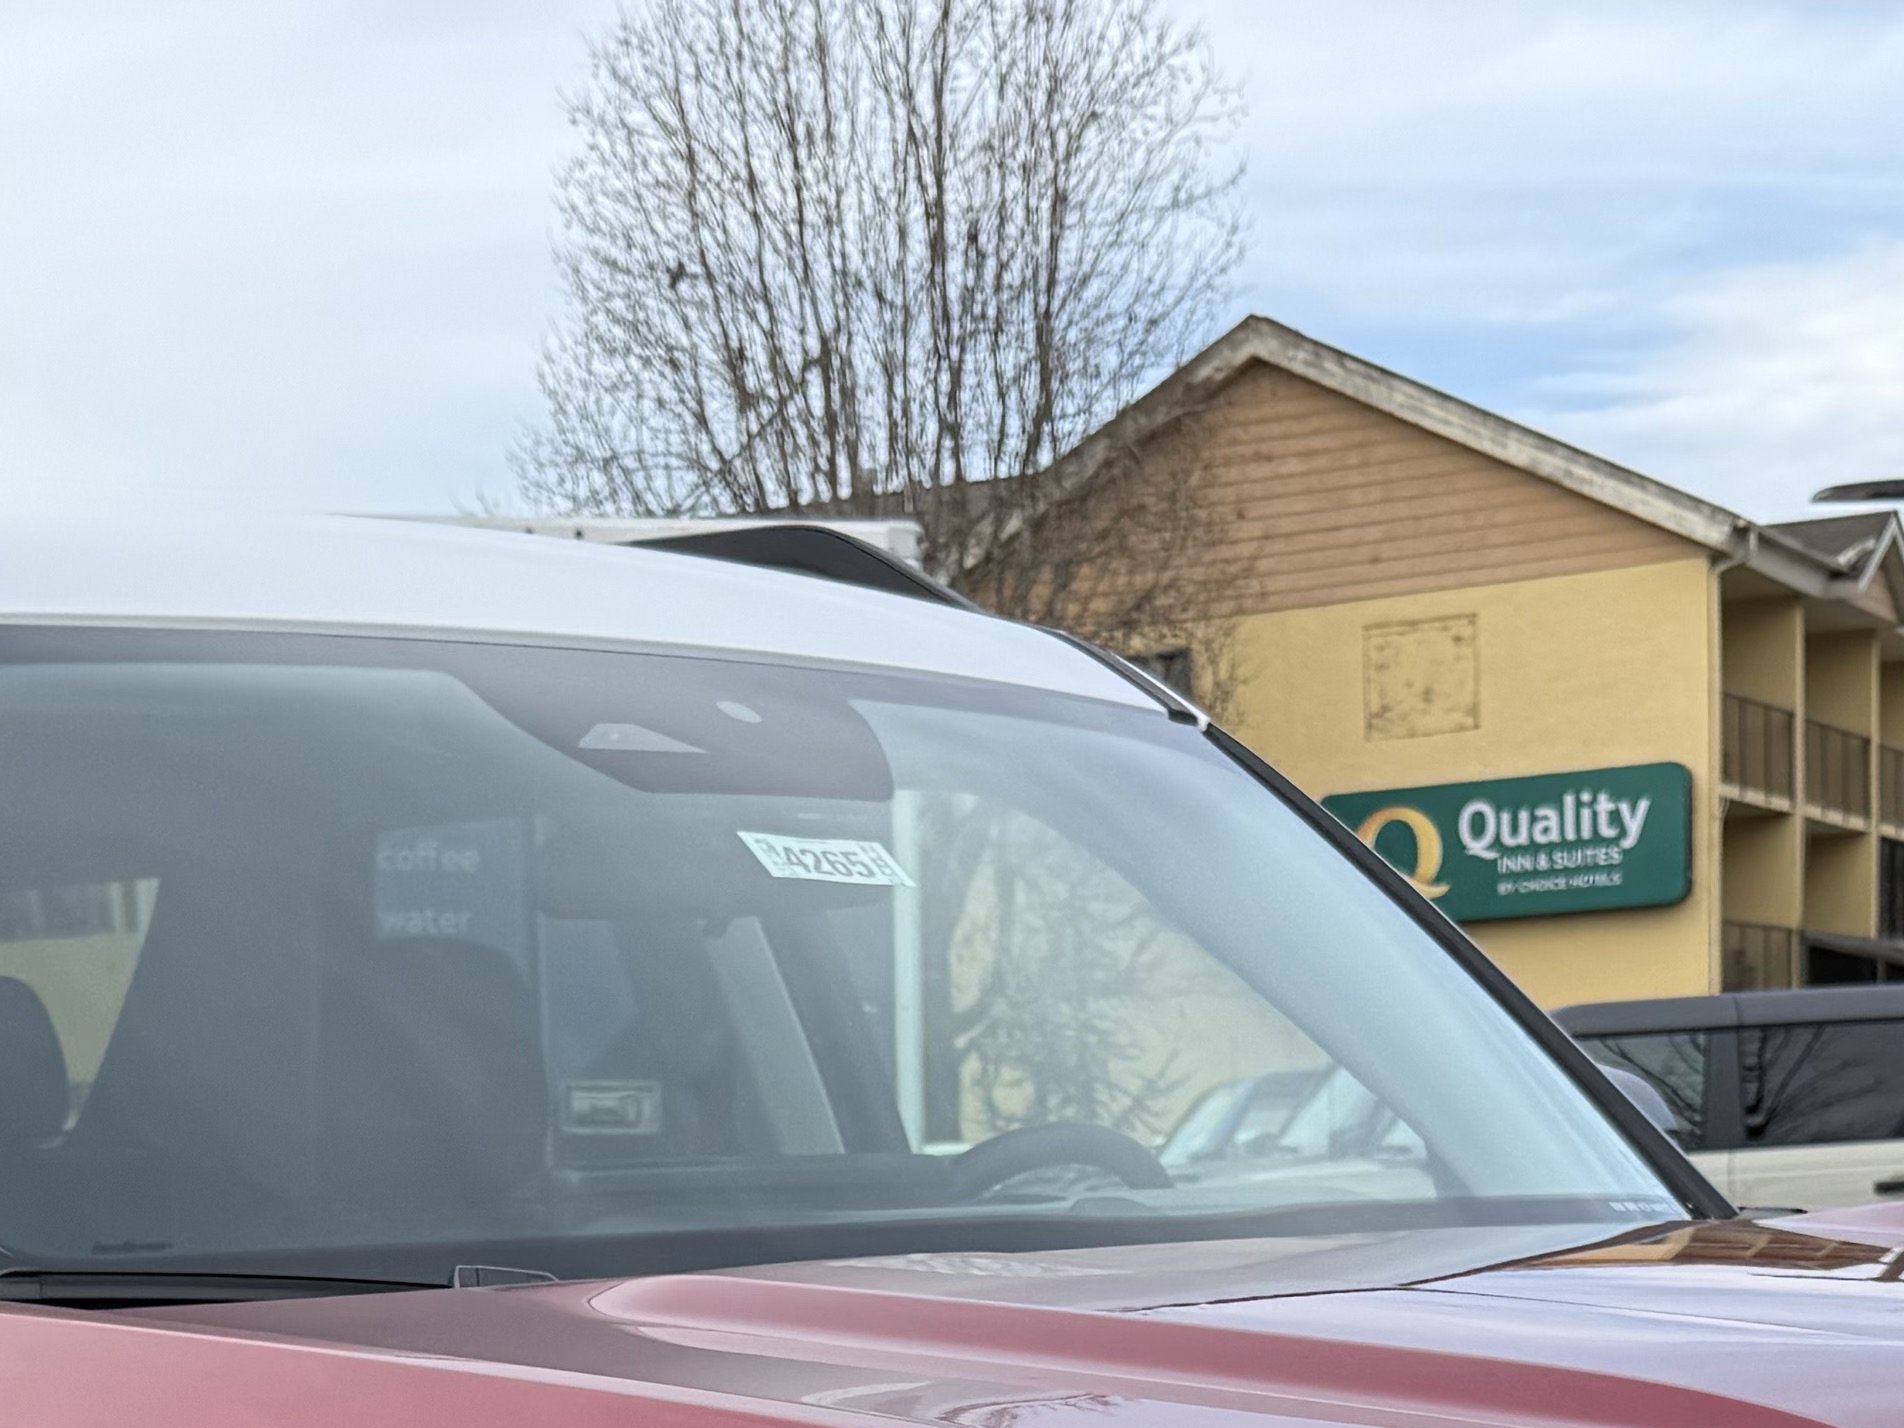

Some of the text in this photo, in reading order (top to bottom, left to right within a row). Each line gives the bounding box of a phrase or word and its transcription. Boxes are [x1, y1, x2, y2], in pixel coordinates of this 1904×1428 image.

[1458, 790, 1651, 860] Quality
[1497, 845, 1622, 875] INN & SUITES
